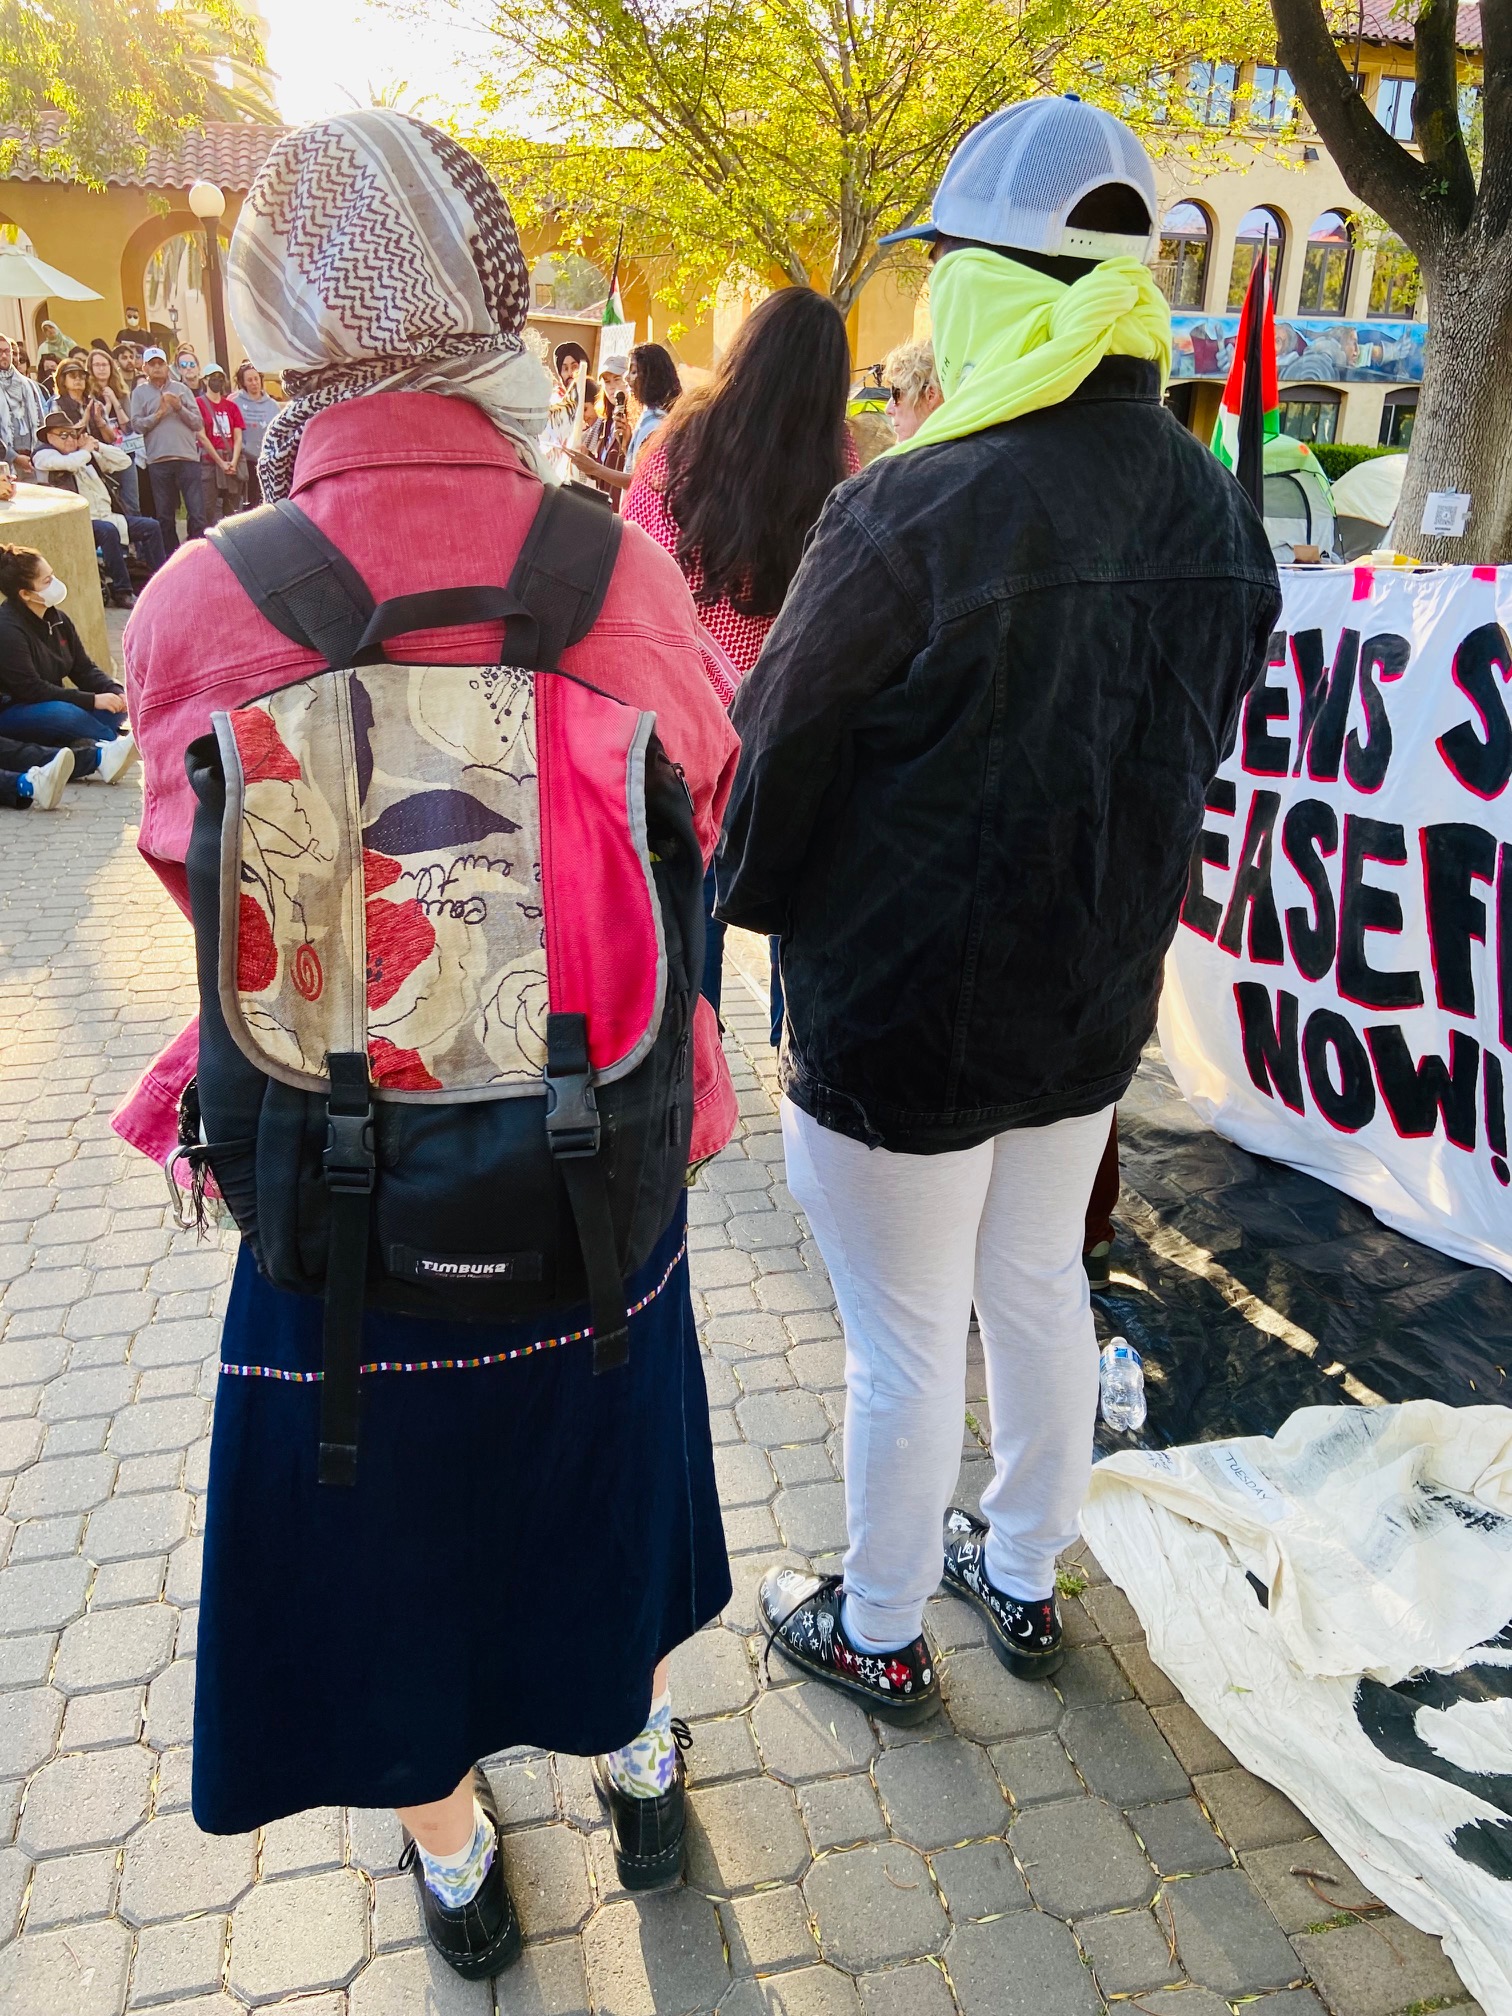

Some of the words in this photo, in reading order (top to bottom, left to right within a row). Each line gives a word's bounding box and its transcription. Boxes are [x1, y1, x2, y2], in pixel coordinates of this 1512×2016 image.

[1242, 627, 1411, 795] EWS
[1180, 777, 1512, 1053] EASEF
[1233, 981, 1511, 1187] NOW!
[422, 1260, 507, 1274] TIMBUK2
[1224, 1451, 1273, 1502] TUESDAY
